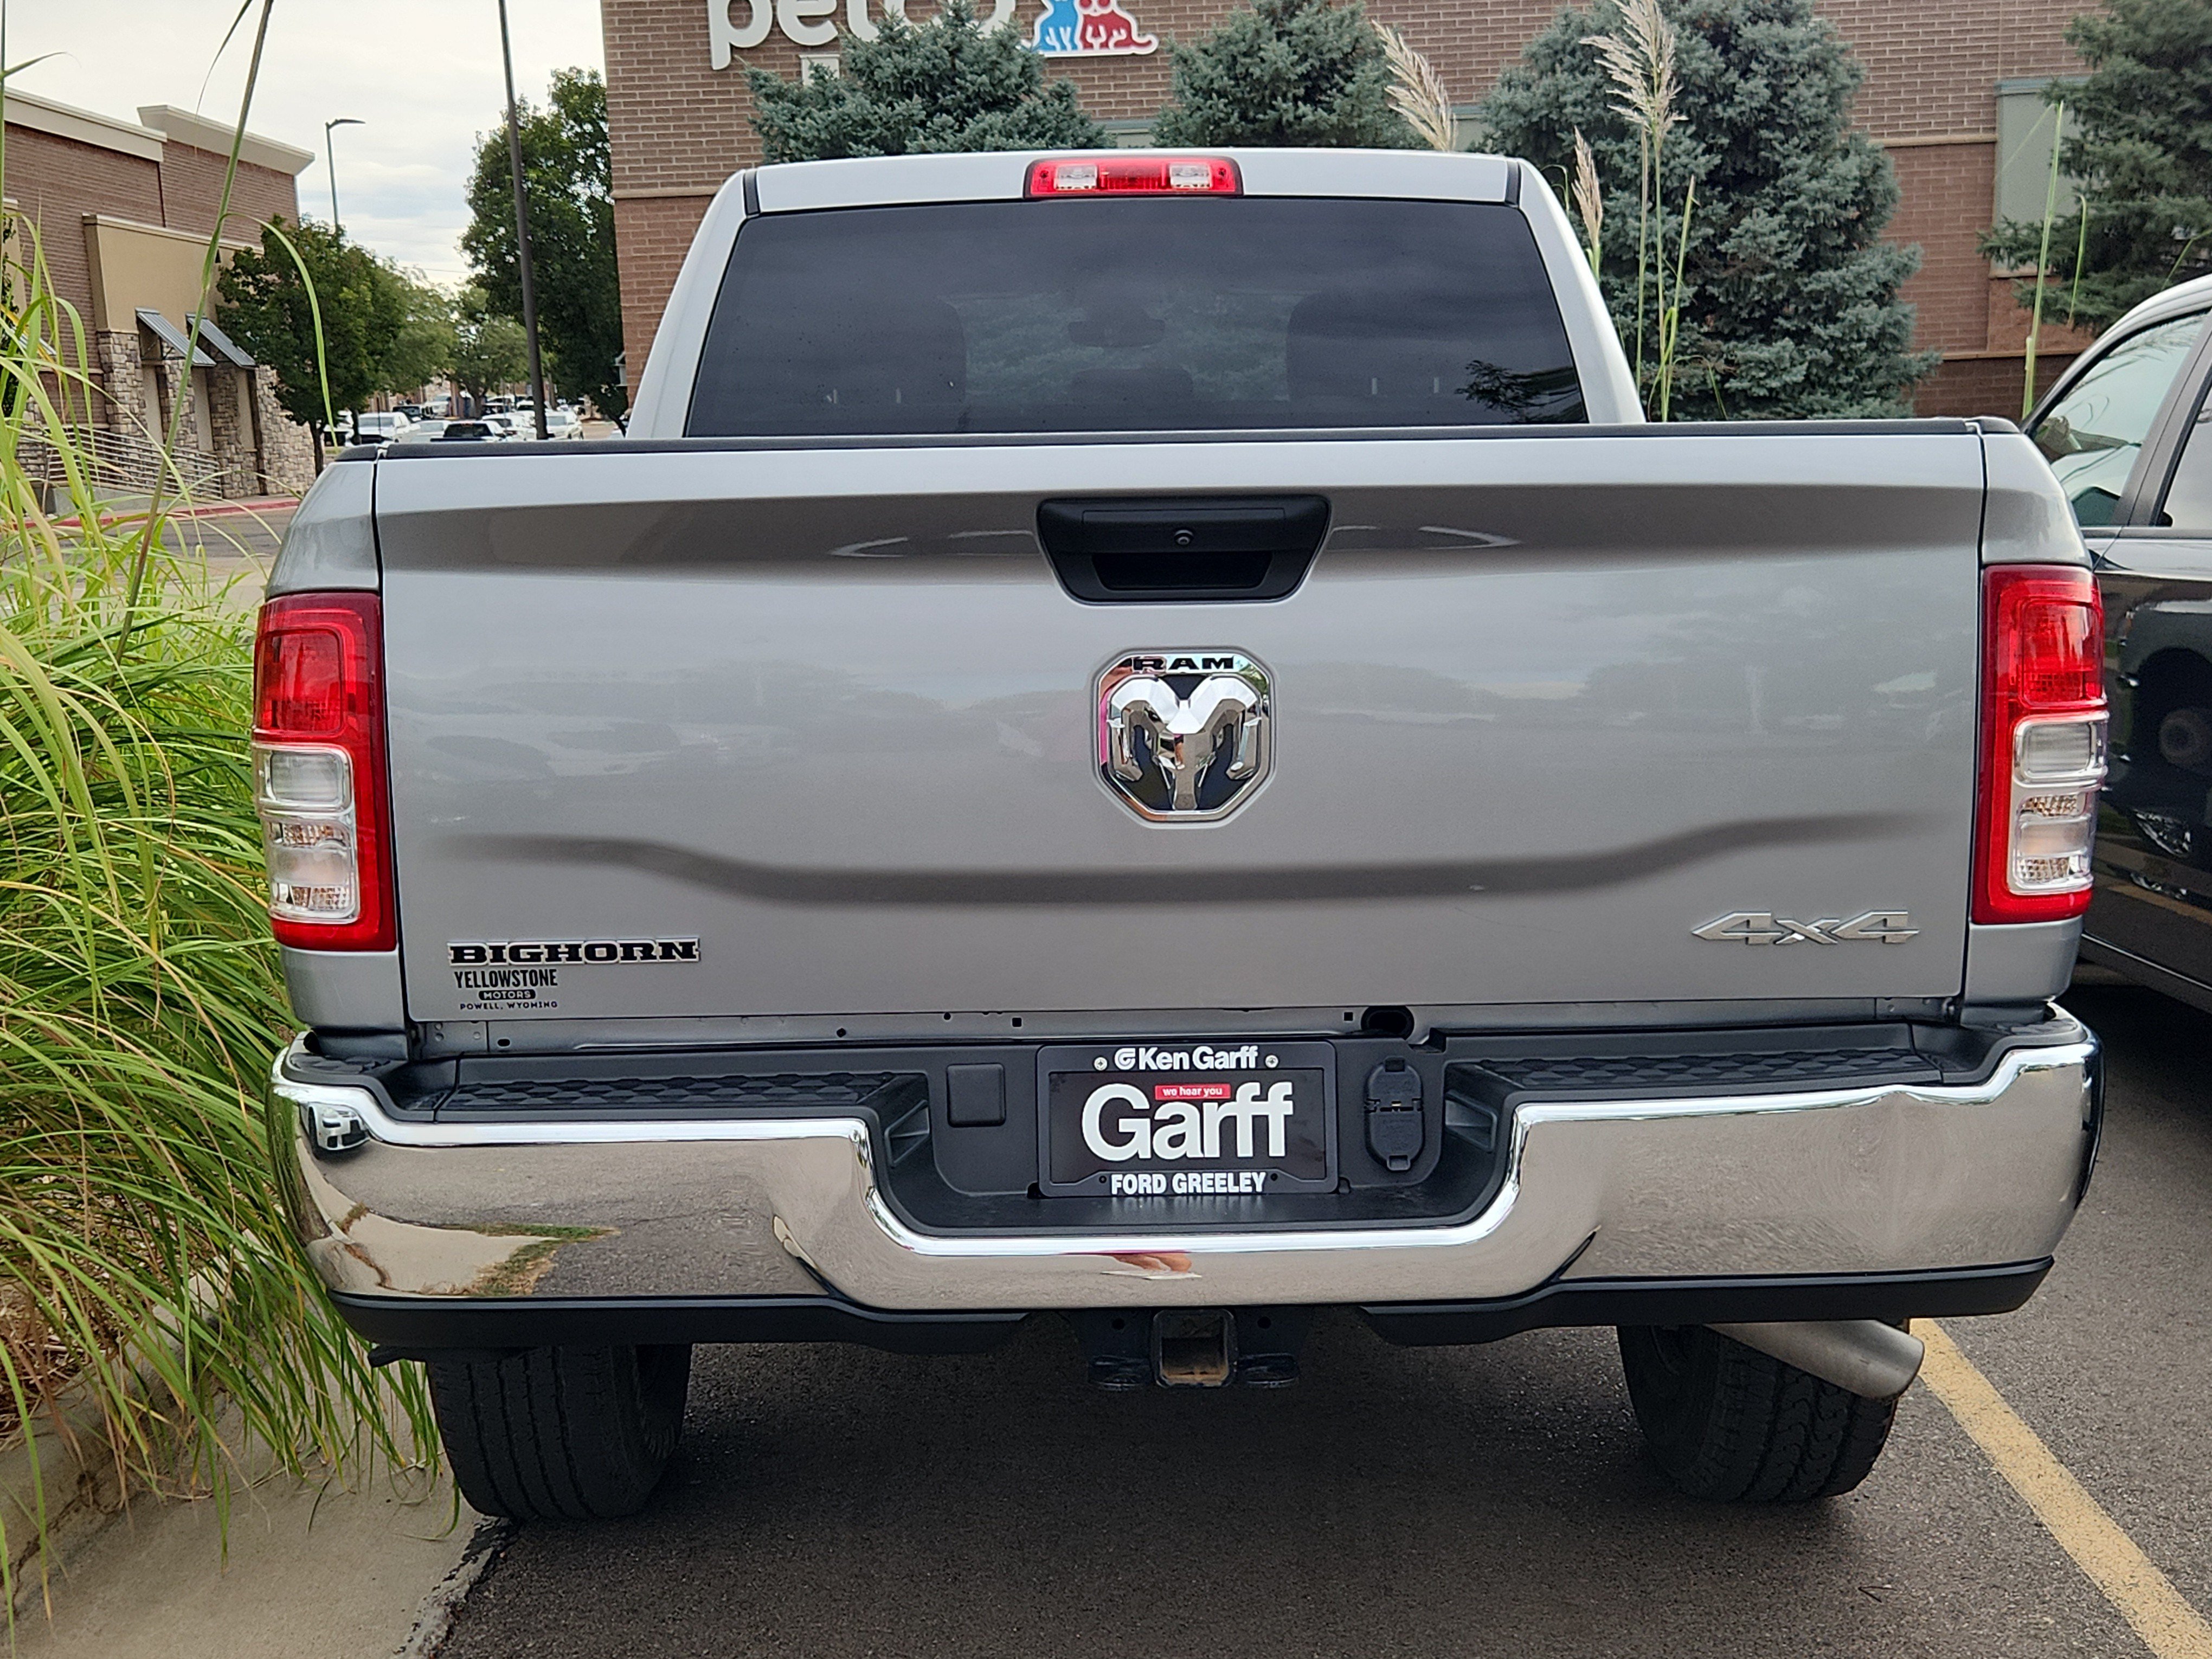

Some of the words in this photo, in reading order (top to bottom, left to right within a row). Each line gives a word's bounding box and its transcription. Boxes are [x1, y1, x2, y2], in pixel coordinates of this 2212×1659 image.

[1133, 658, 1234, 671] RAM
[1692, 910, 1920, 944] 4x4
[448, 938, 700, 966] BIGHORN
[454, 969, 558, 988] YELLOWSTONE
[483, 991, 532, 999] MOTORS
[460, 1002, 503, 1011] POWELL,
[507, 1001, 558, 1009] WYOMING
[1139, 1047, 1188, 1070] Ken
[1192, 1046, 1258, 1070] Garff
[1204, 1088, 1223, 1098] you
[1082, 1082, 1294, 1161] Garff
[1111, 1173, 1167, 1194] FORD
[1172, 1172, 1266, 1193] GREELEY
